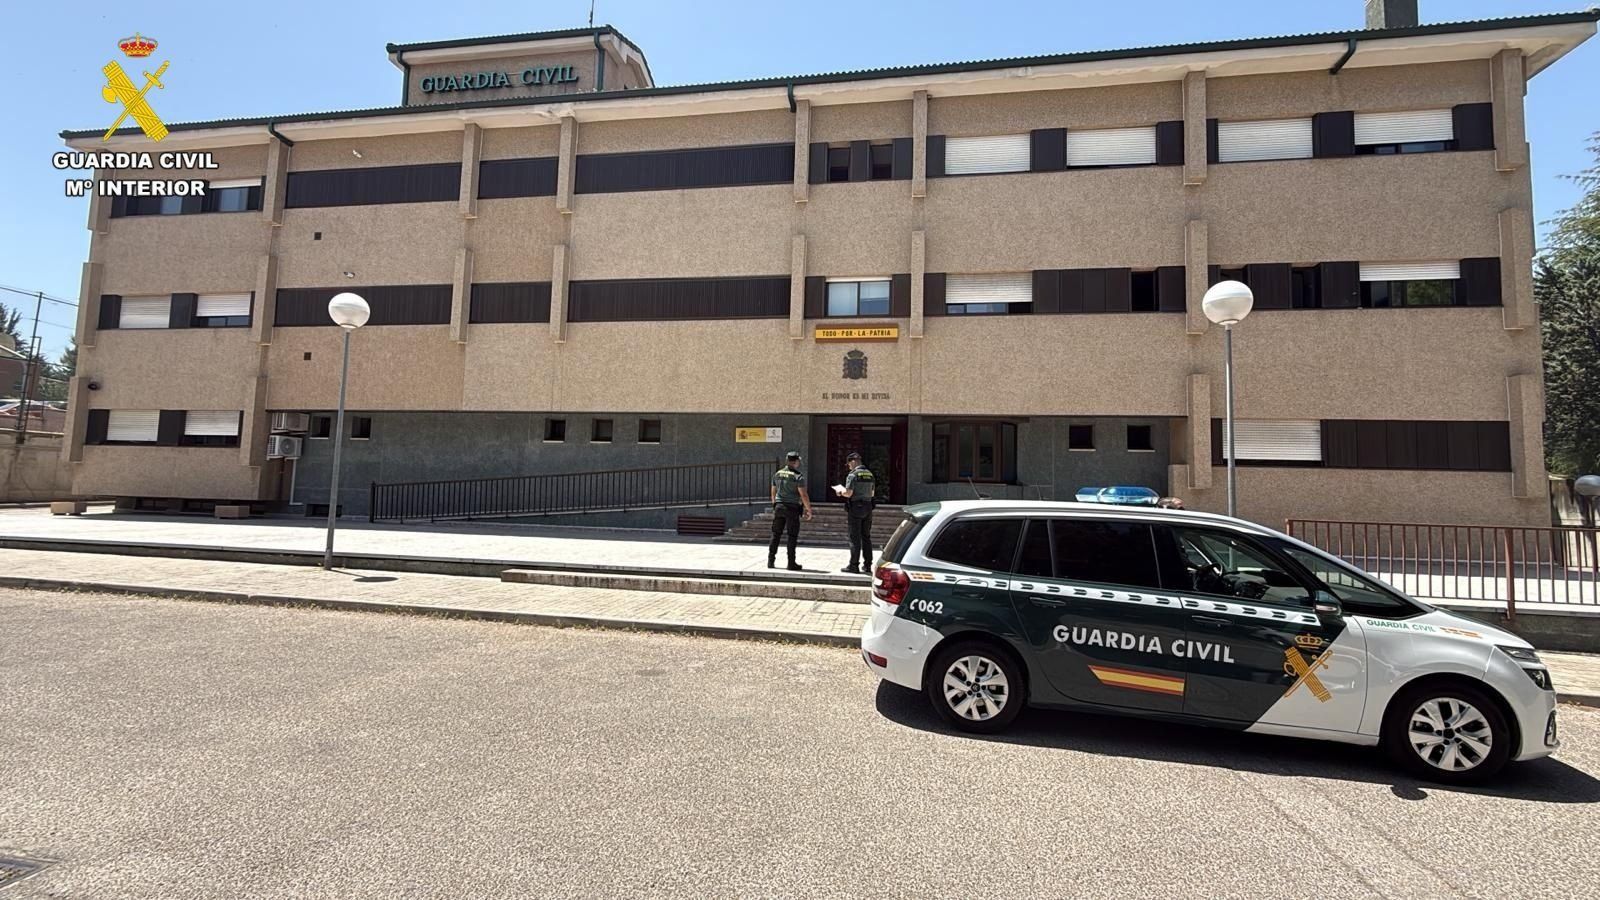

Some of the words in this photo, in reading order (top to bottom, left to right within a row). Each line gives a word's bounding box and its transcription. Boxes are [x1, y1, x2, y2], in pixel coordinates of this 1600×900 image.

[420, 72, 512, 93] GUARDIA
[520, 64, 578, 84] CIVIL
[918, 599, 944, 614] 062
[1366, 619, 1409, 629] GUARDIA
[1412, 624, 1436, 632] CIVIL
[1052, 624, 1163, 655] GUARDIA
[1171, 639, 1235, 664] CIVIL
